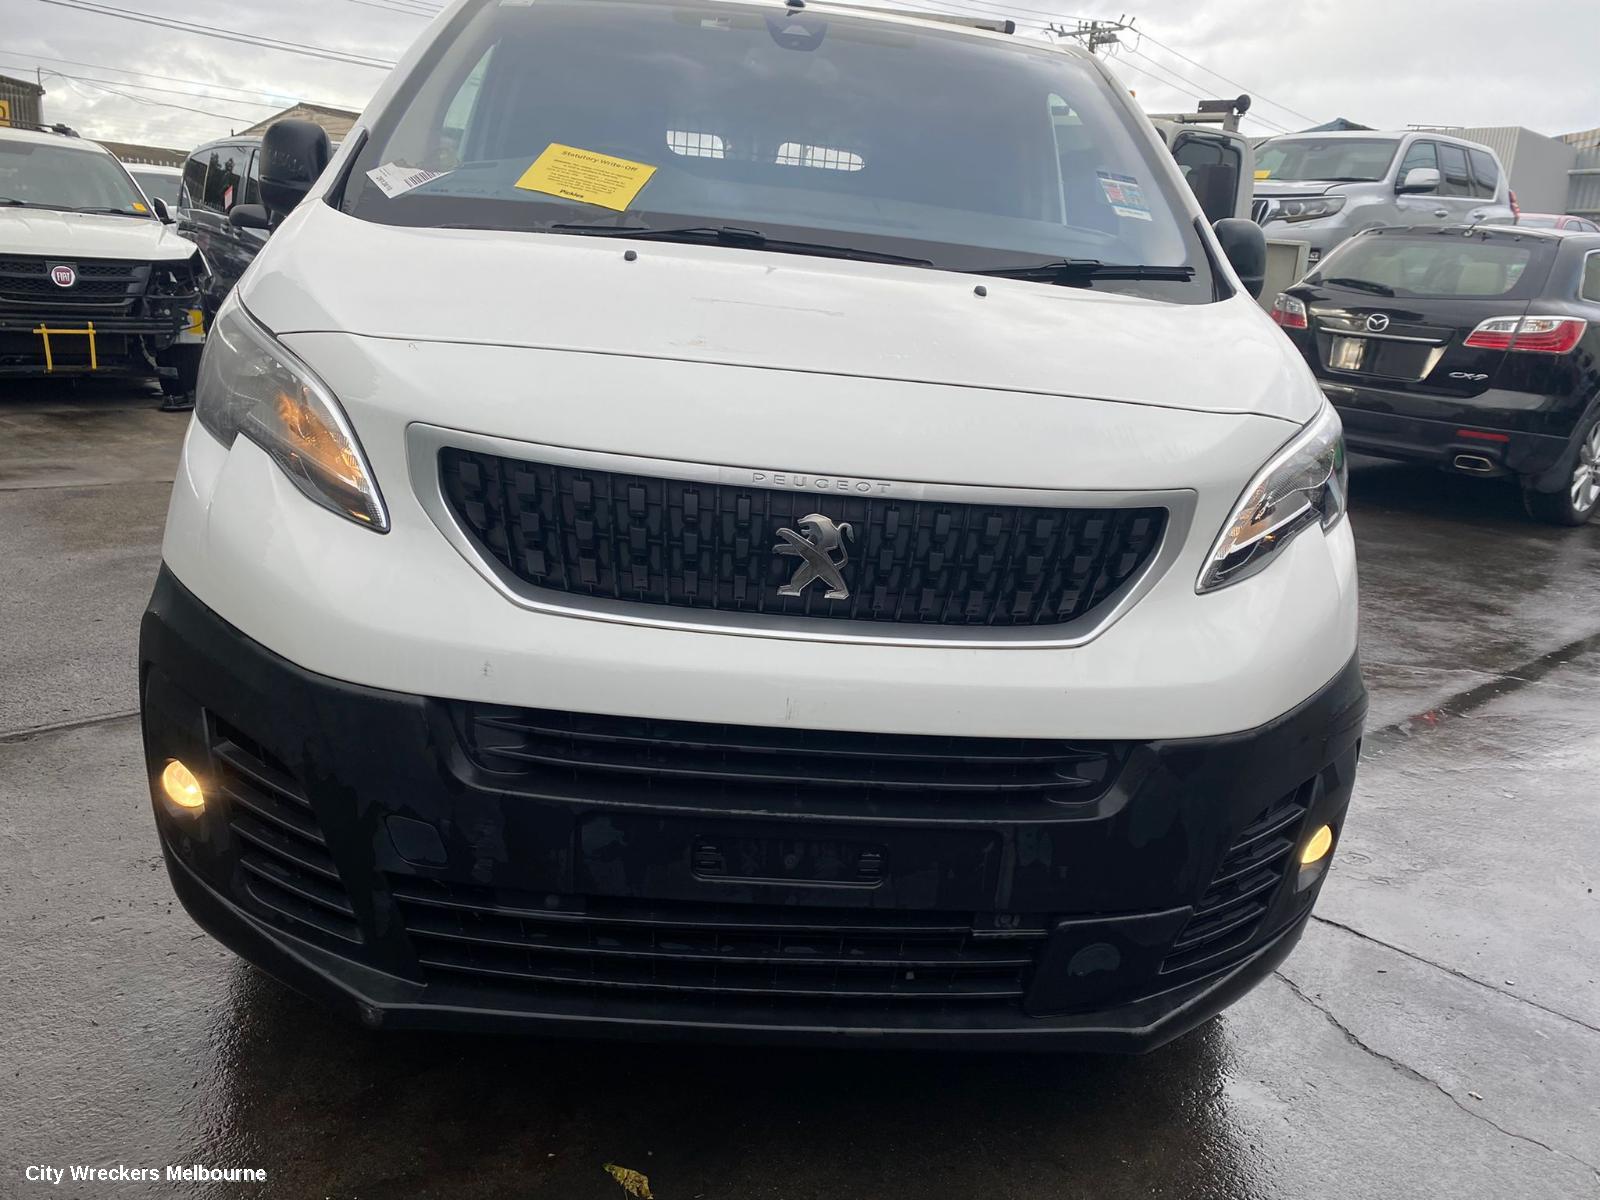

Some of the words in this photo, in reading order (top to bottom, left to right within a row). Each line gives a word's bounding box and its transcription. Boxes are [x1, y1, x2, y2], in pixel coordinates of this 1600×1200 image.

[561, 150, 599, 164] Statutory
[600, 159, 639, 172] Write-Off
[56, 271, 70, 282] FIAT
[752, 472, 891, 494] PEUGEOT
